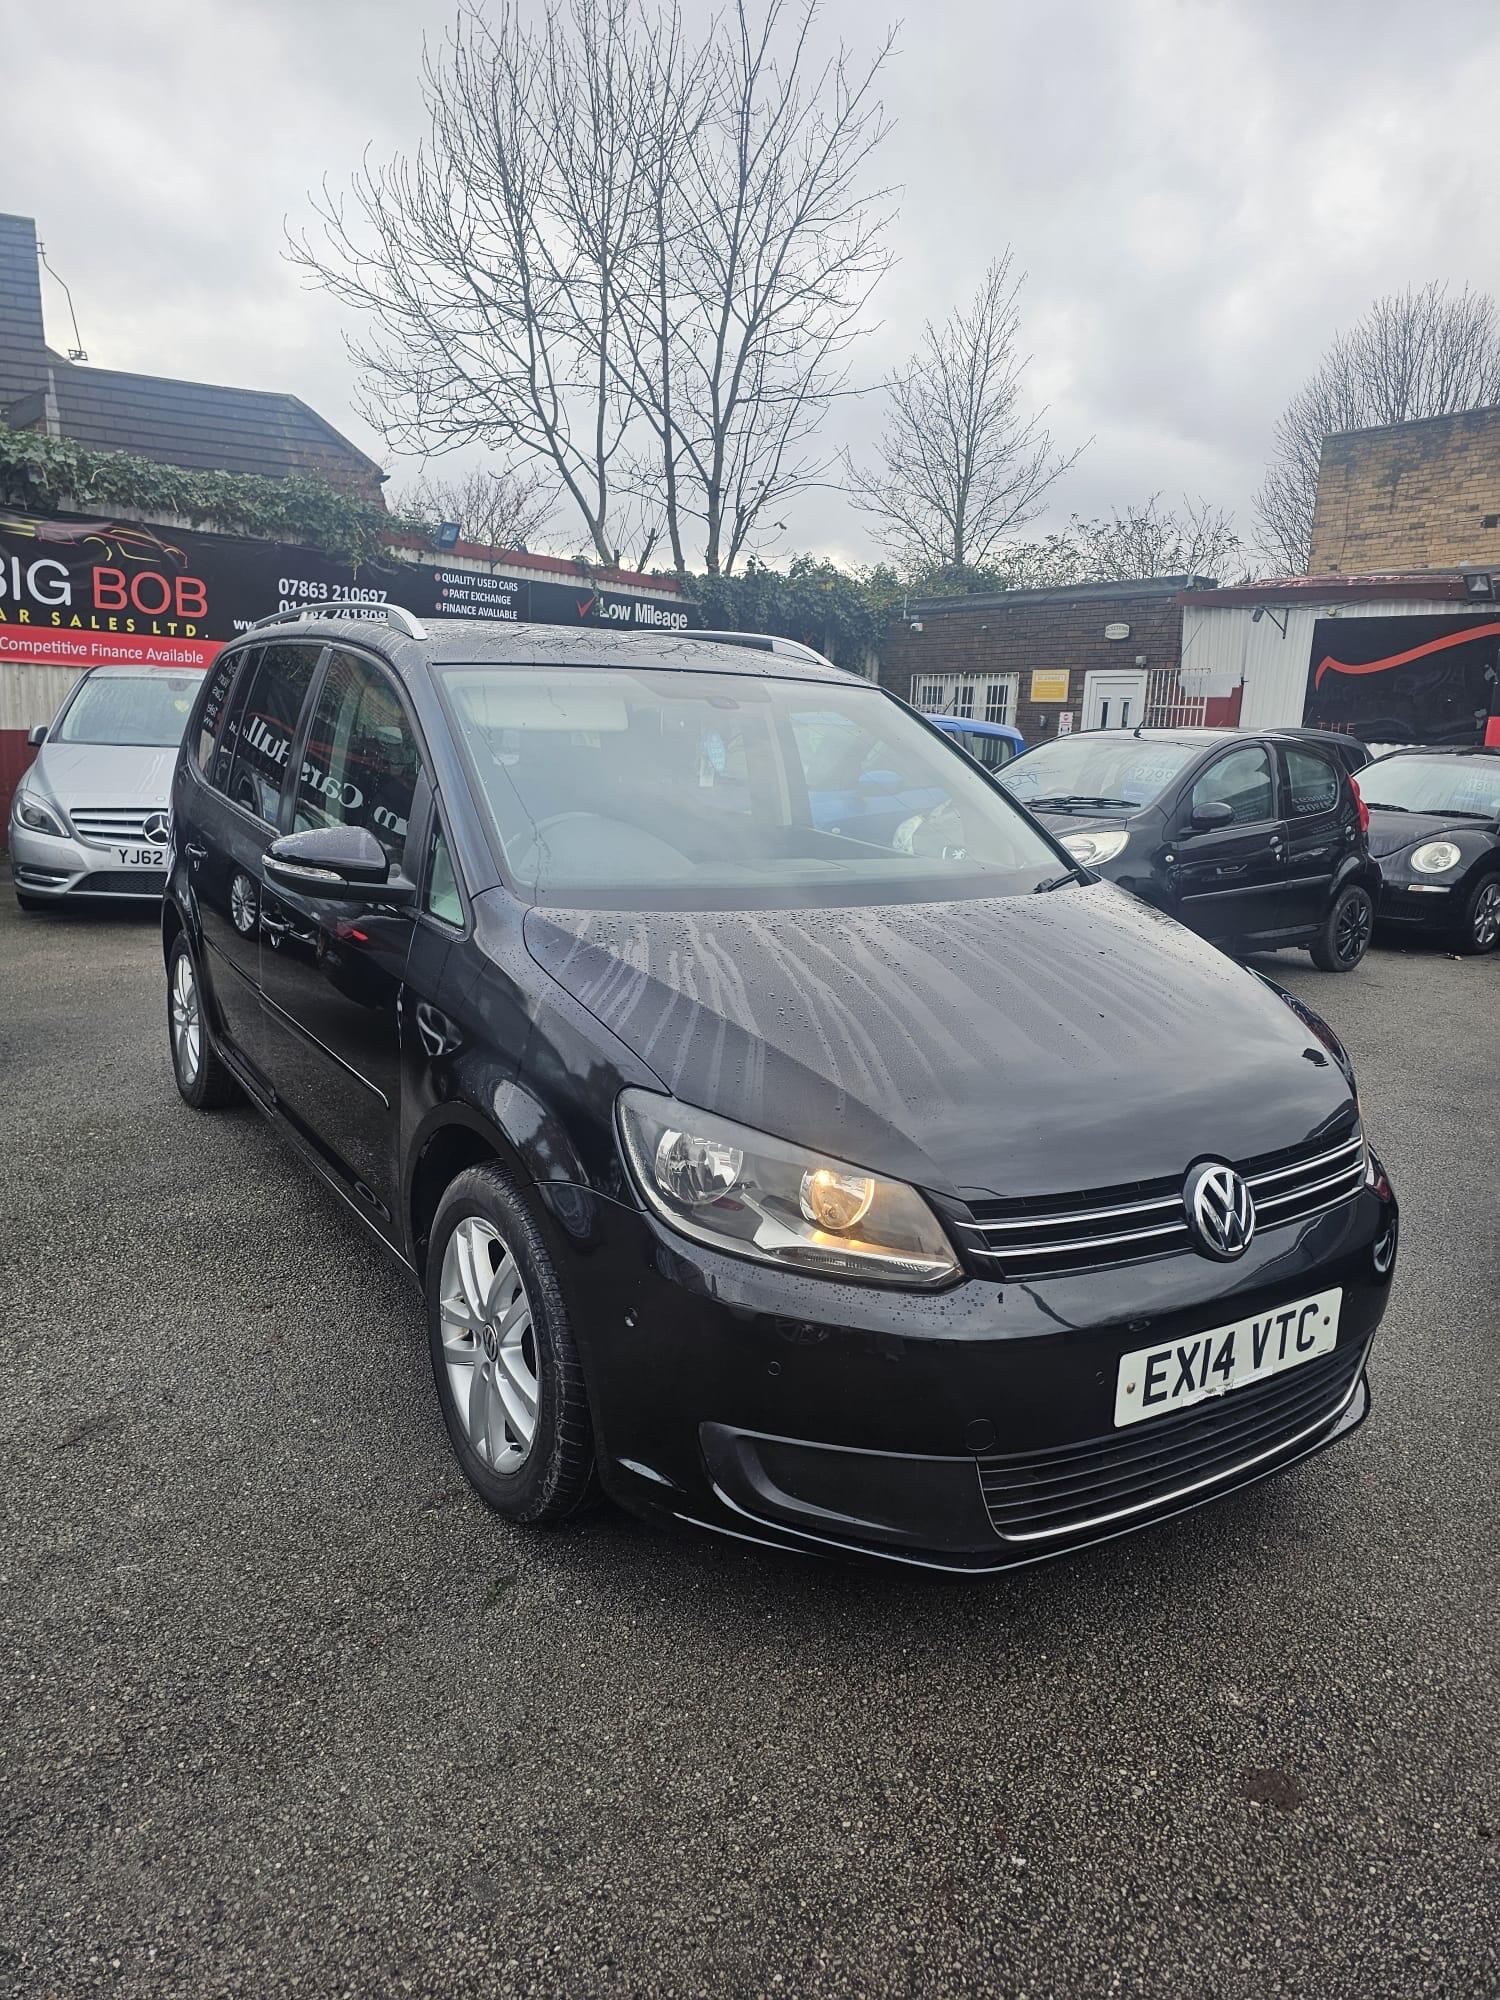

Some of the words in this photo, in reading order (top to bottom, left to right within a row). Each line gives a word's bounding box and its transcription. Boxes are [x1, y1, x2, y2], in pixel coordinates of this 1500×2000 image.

[0, 555, 72, 606] IG
[93, 566, 208, 618] BOB
[278, 578, 328, 599] 07863
[332, 584, 388, 603] 210697
[441, 572, 476, 586] QUALITY
[477, 577, 498, 589] USED
[498, 580, 518, 592] CARS
[449, 588, 470, 600] PART
[470, 591, 512, 605] EXCHANGE
[51, 611, 136, 632] SALES
[442, 602, 477, 615] FINANCE
[478, 606, 518, 620] AVALIABLE
[599, 597, 631, 621] Low
[635, 602, 688, 631] Mileage
[0, 636, 88, 655] Competitive
[91, 643, 143, 660] Finance
[146, 647, 204, 664] Available
[1317, 721, 1357, 736] THE
[118, 848, 163, 865] YJ62
[1142, 1330, 1236, 1407] EX14
[1252, 1302, 1319, 1370] VTC
